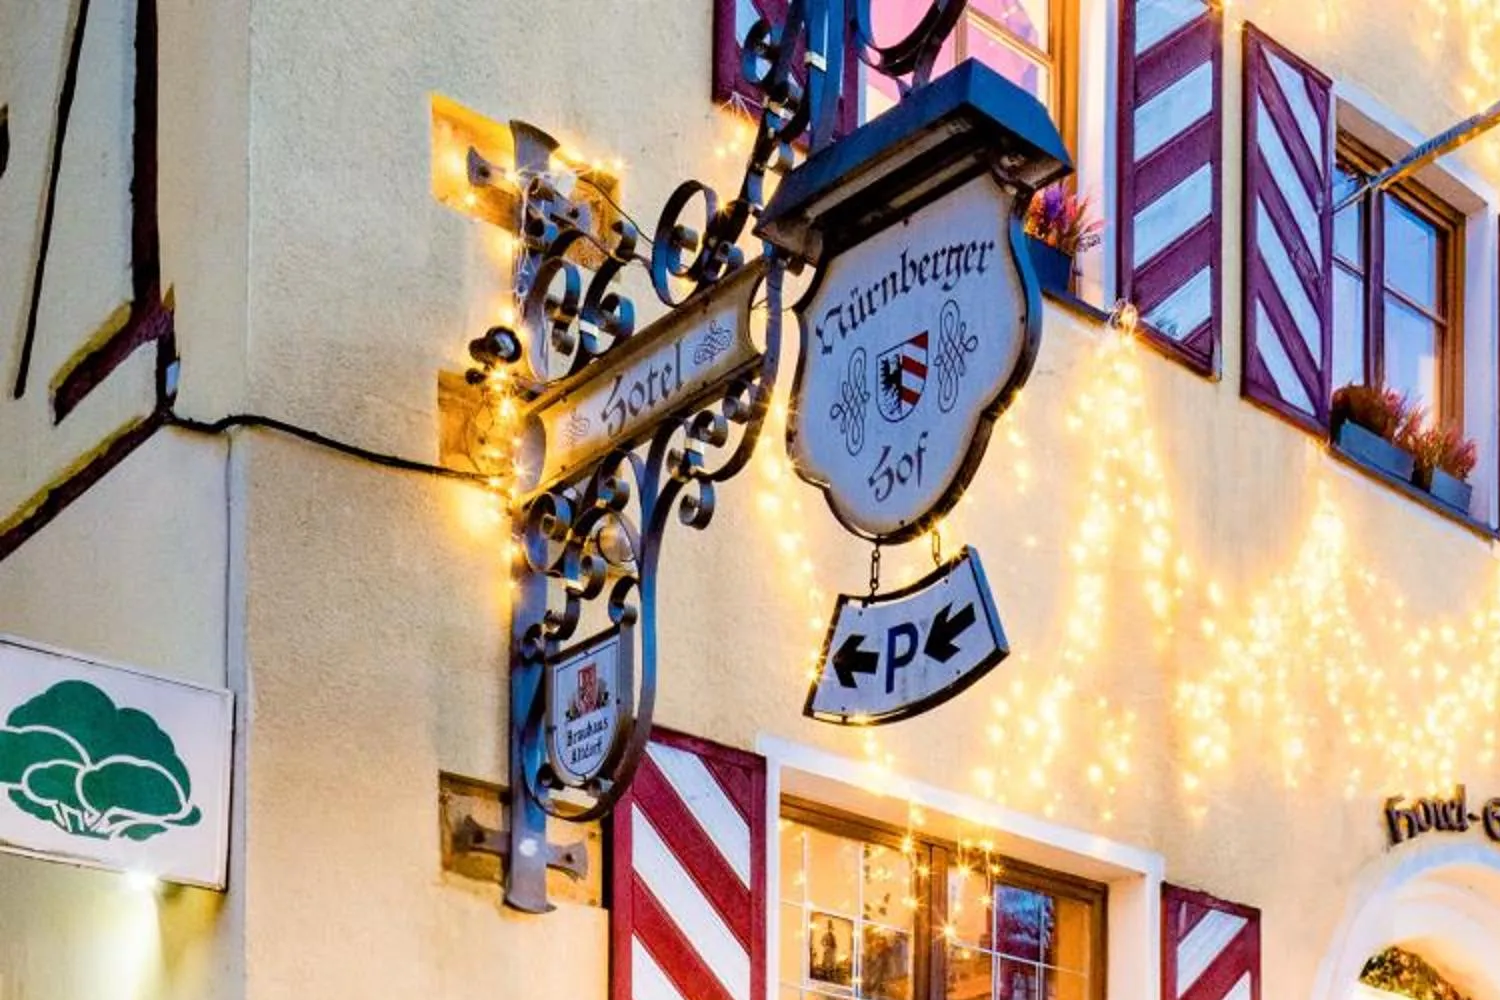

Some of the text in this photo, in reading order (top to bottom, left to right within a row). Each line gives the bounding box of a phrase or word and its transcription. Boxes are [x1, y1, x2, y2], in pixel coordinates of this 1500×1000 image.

[815, 239, 995, 355] Nürnberger
[601, 338, 684, 438] Hotel
[867, 431, 929, 502] Hof
[885, 622, 919, 693] P
